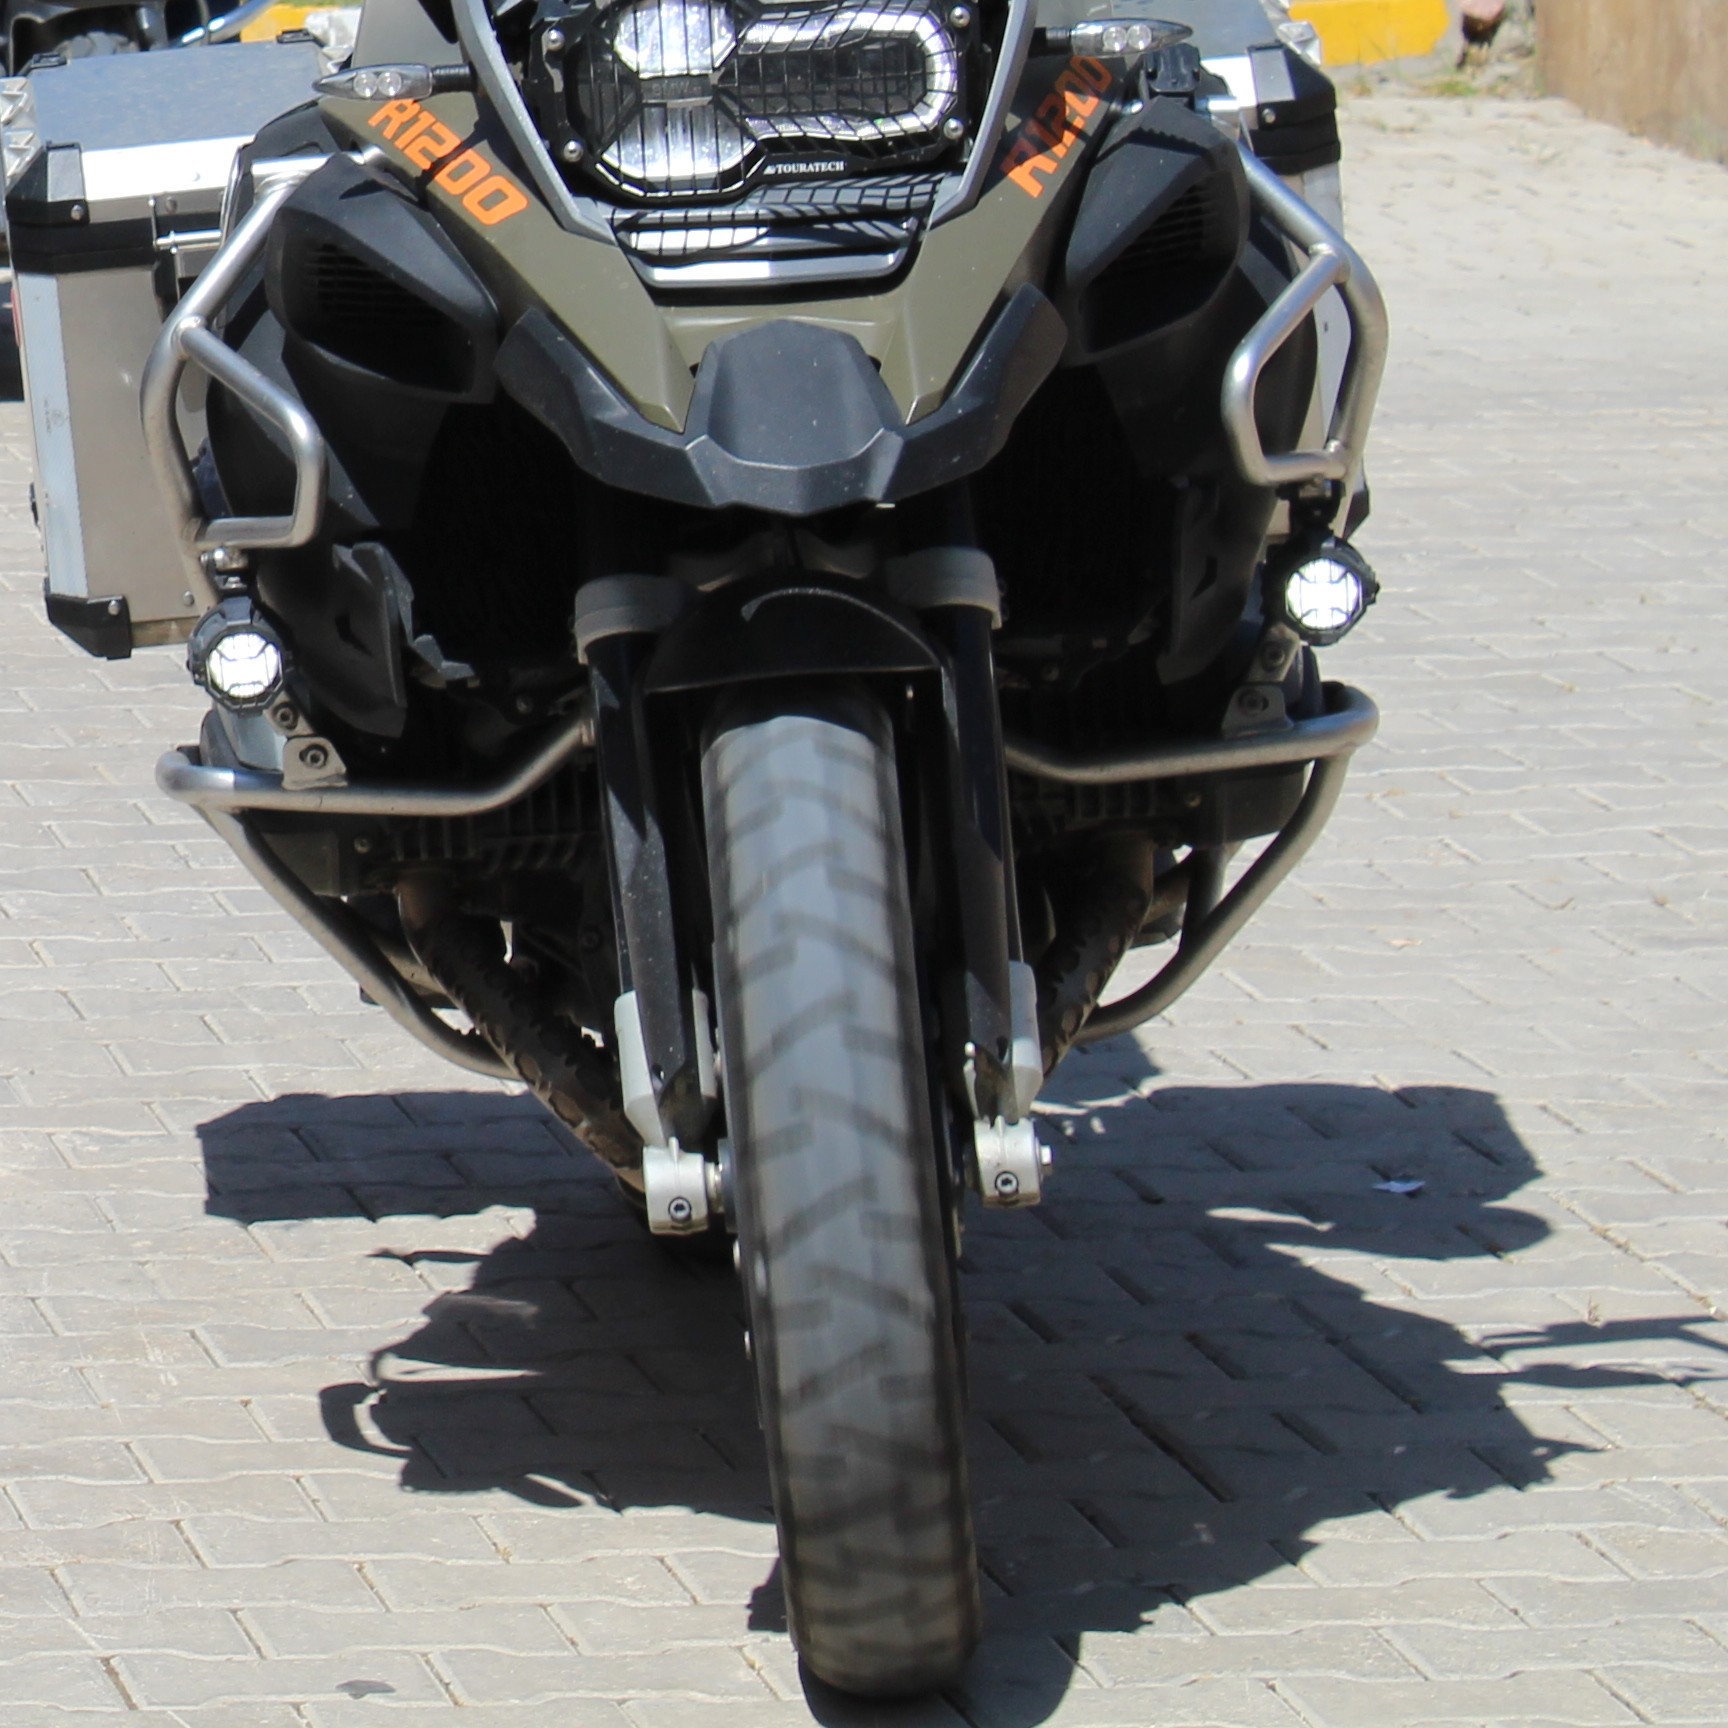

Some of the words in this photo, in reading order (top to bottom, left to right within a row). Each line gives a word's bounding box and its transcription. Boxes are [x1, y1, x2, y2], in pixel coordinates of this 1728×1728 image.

[367, 98, 530, 226] R1200
[775, 160, 845, 175] TOURATECH
[1000, 55, 1114, 199] R1200
